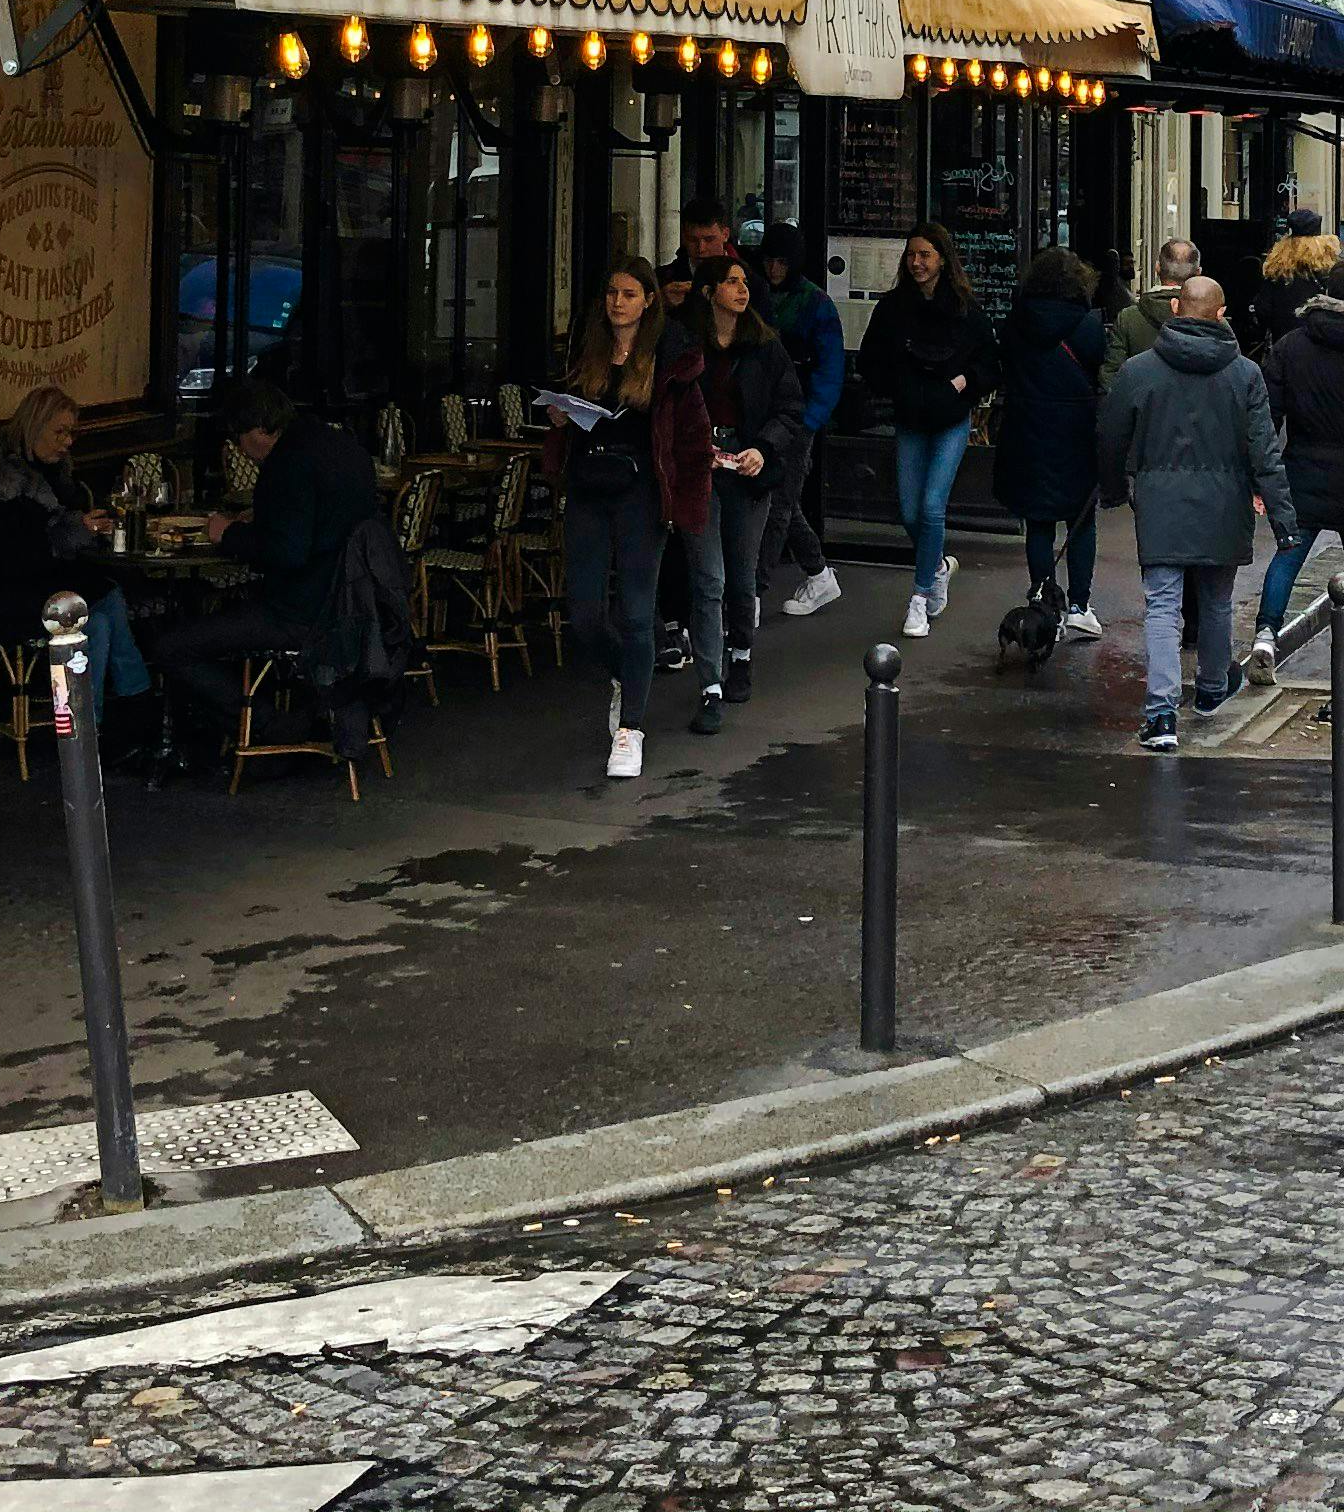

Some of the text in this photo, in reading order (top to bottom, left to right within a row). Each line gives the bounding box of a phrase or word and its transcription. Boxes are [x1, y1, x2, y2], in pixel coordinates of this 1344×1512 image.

[63, 184, 99, 226] FRAIS
[35, 246, 95, 302] MAISON
[56, 278, 116, 344] HEURE
